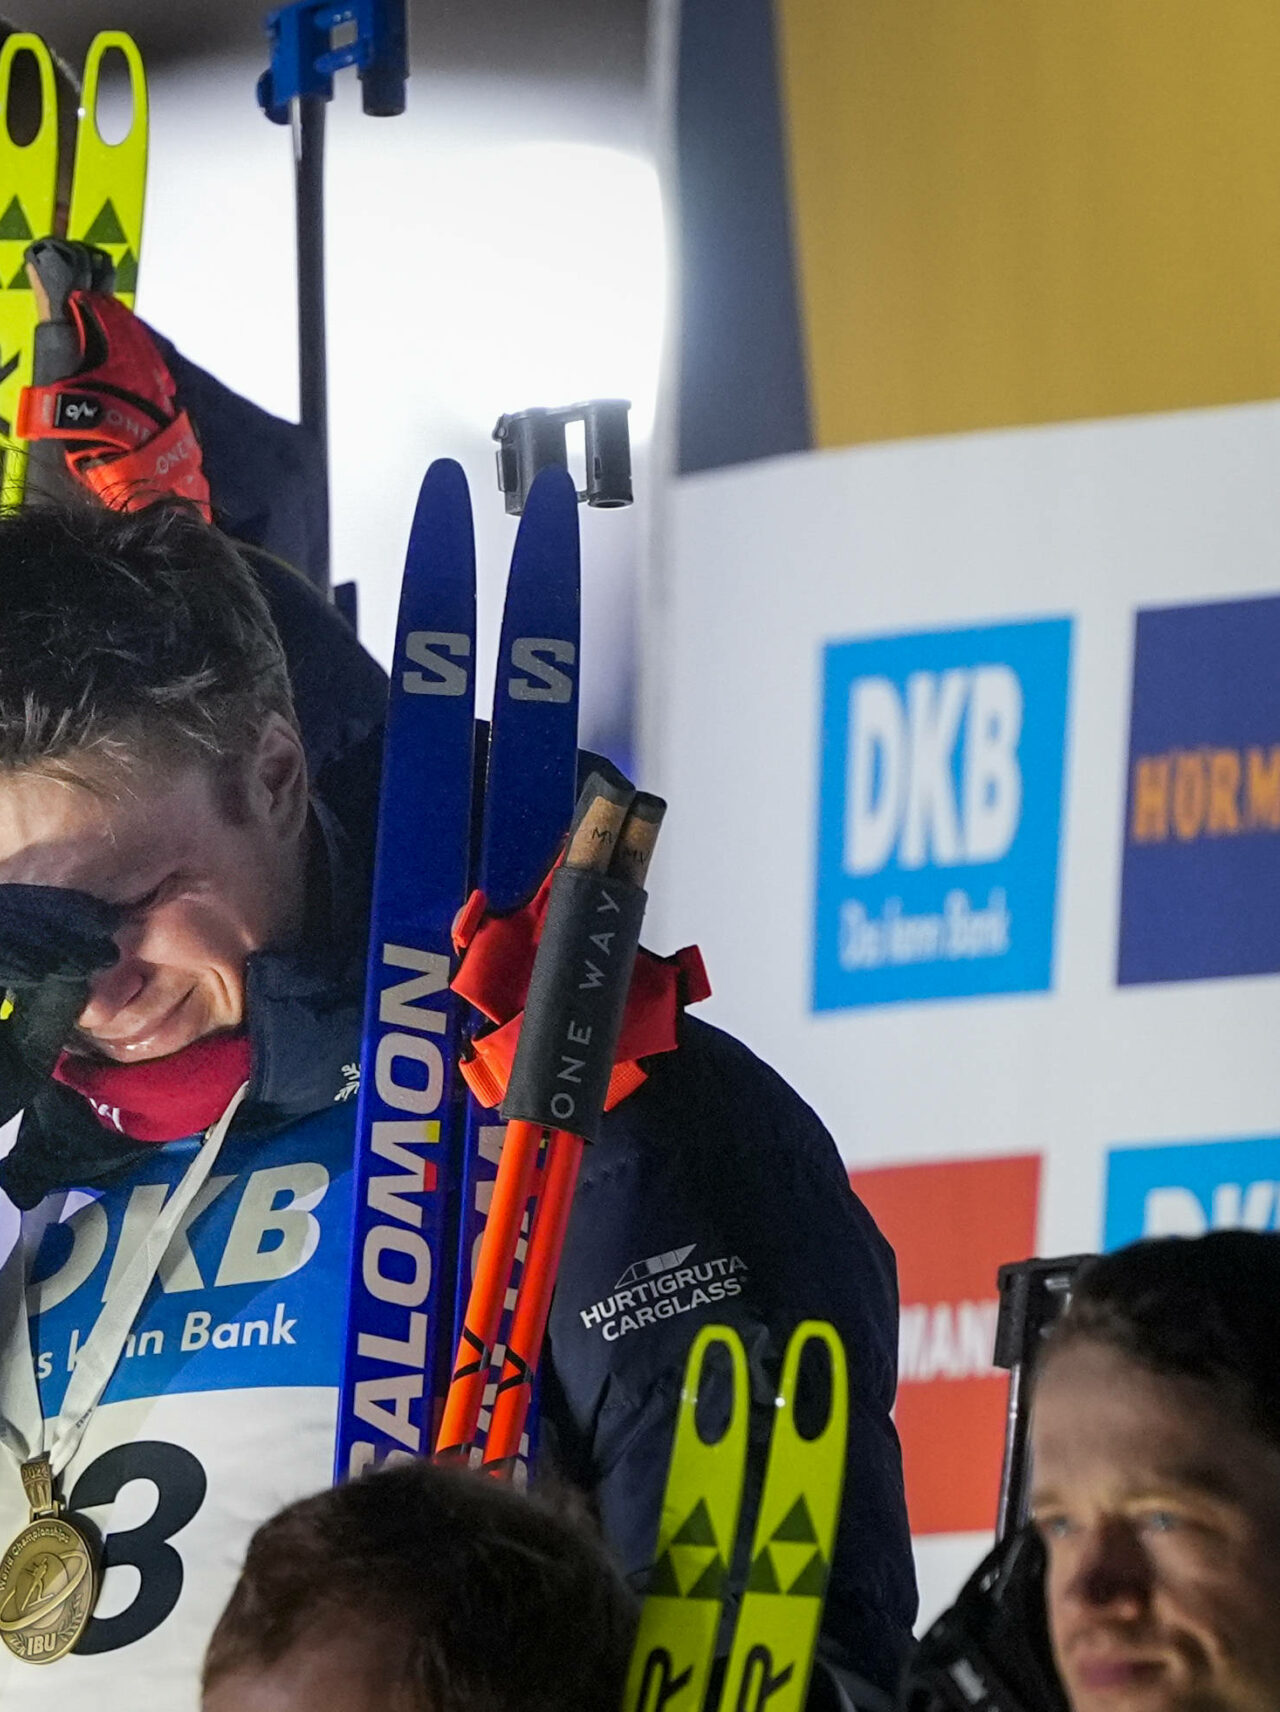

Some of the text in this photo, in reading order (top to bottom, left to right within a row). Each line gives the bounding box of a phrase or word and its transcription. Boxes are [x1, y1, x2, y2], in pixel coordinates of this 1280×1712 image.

[402, 631, 471, 696] S
[508, 637, 576, 703] S
[843, 663, 1023, 878] DKB
[550, 890, 621, 1120] ONE WAY
[19, 1161, 330, 1322] DKB
[179, 1302, 298, 1352] Bank
[578, 1255, 749, 1330] HURTIGRUTA
[601, 1277, 743, 1342] CARGLASS
[68, 1439, 208, 1656] 3
[26, 1633, 57, 1656] IBU
